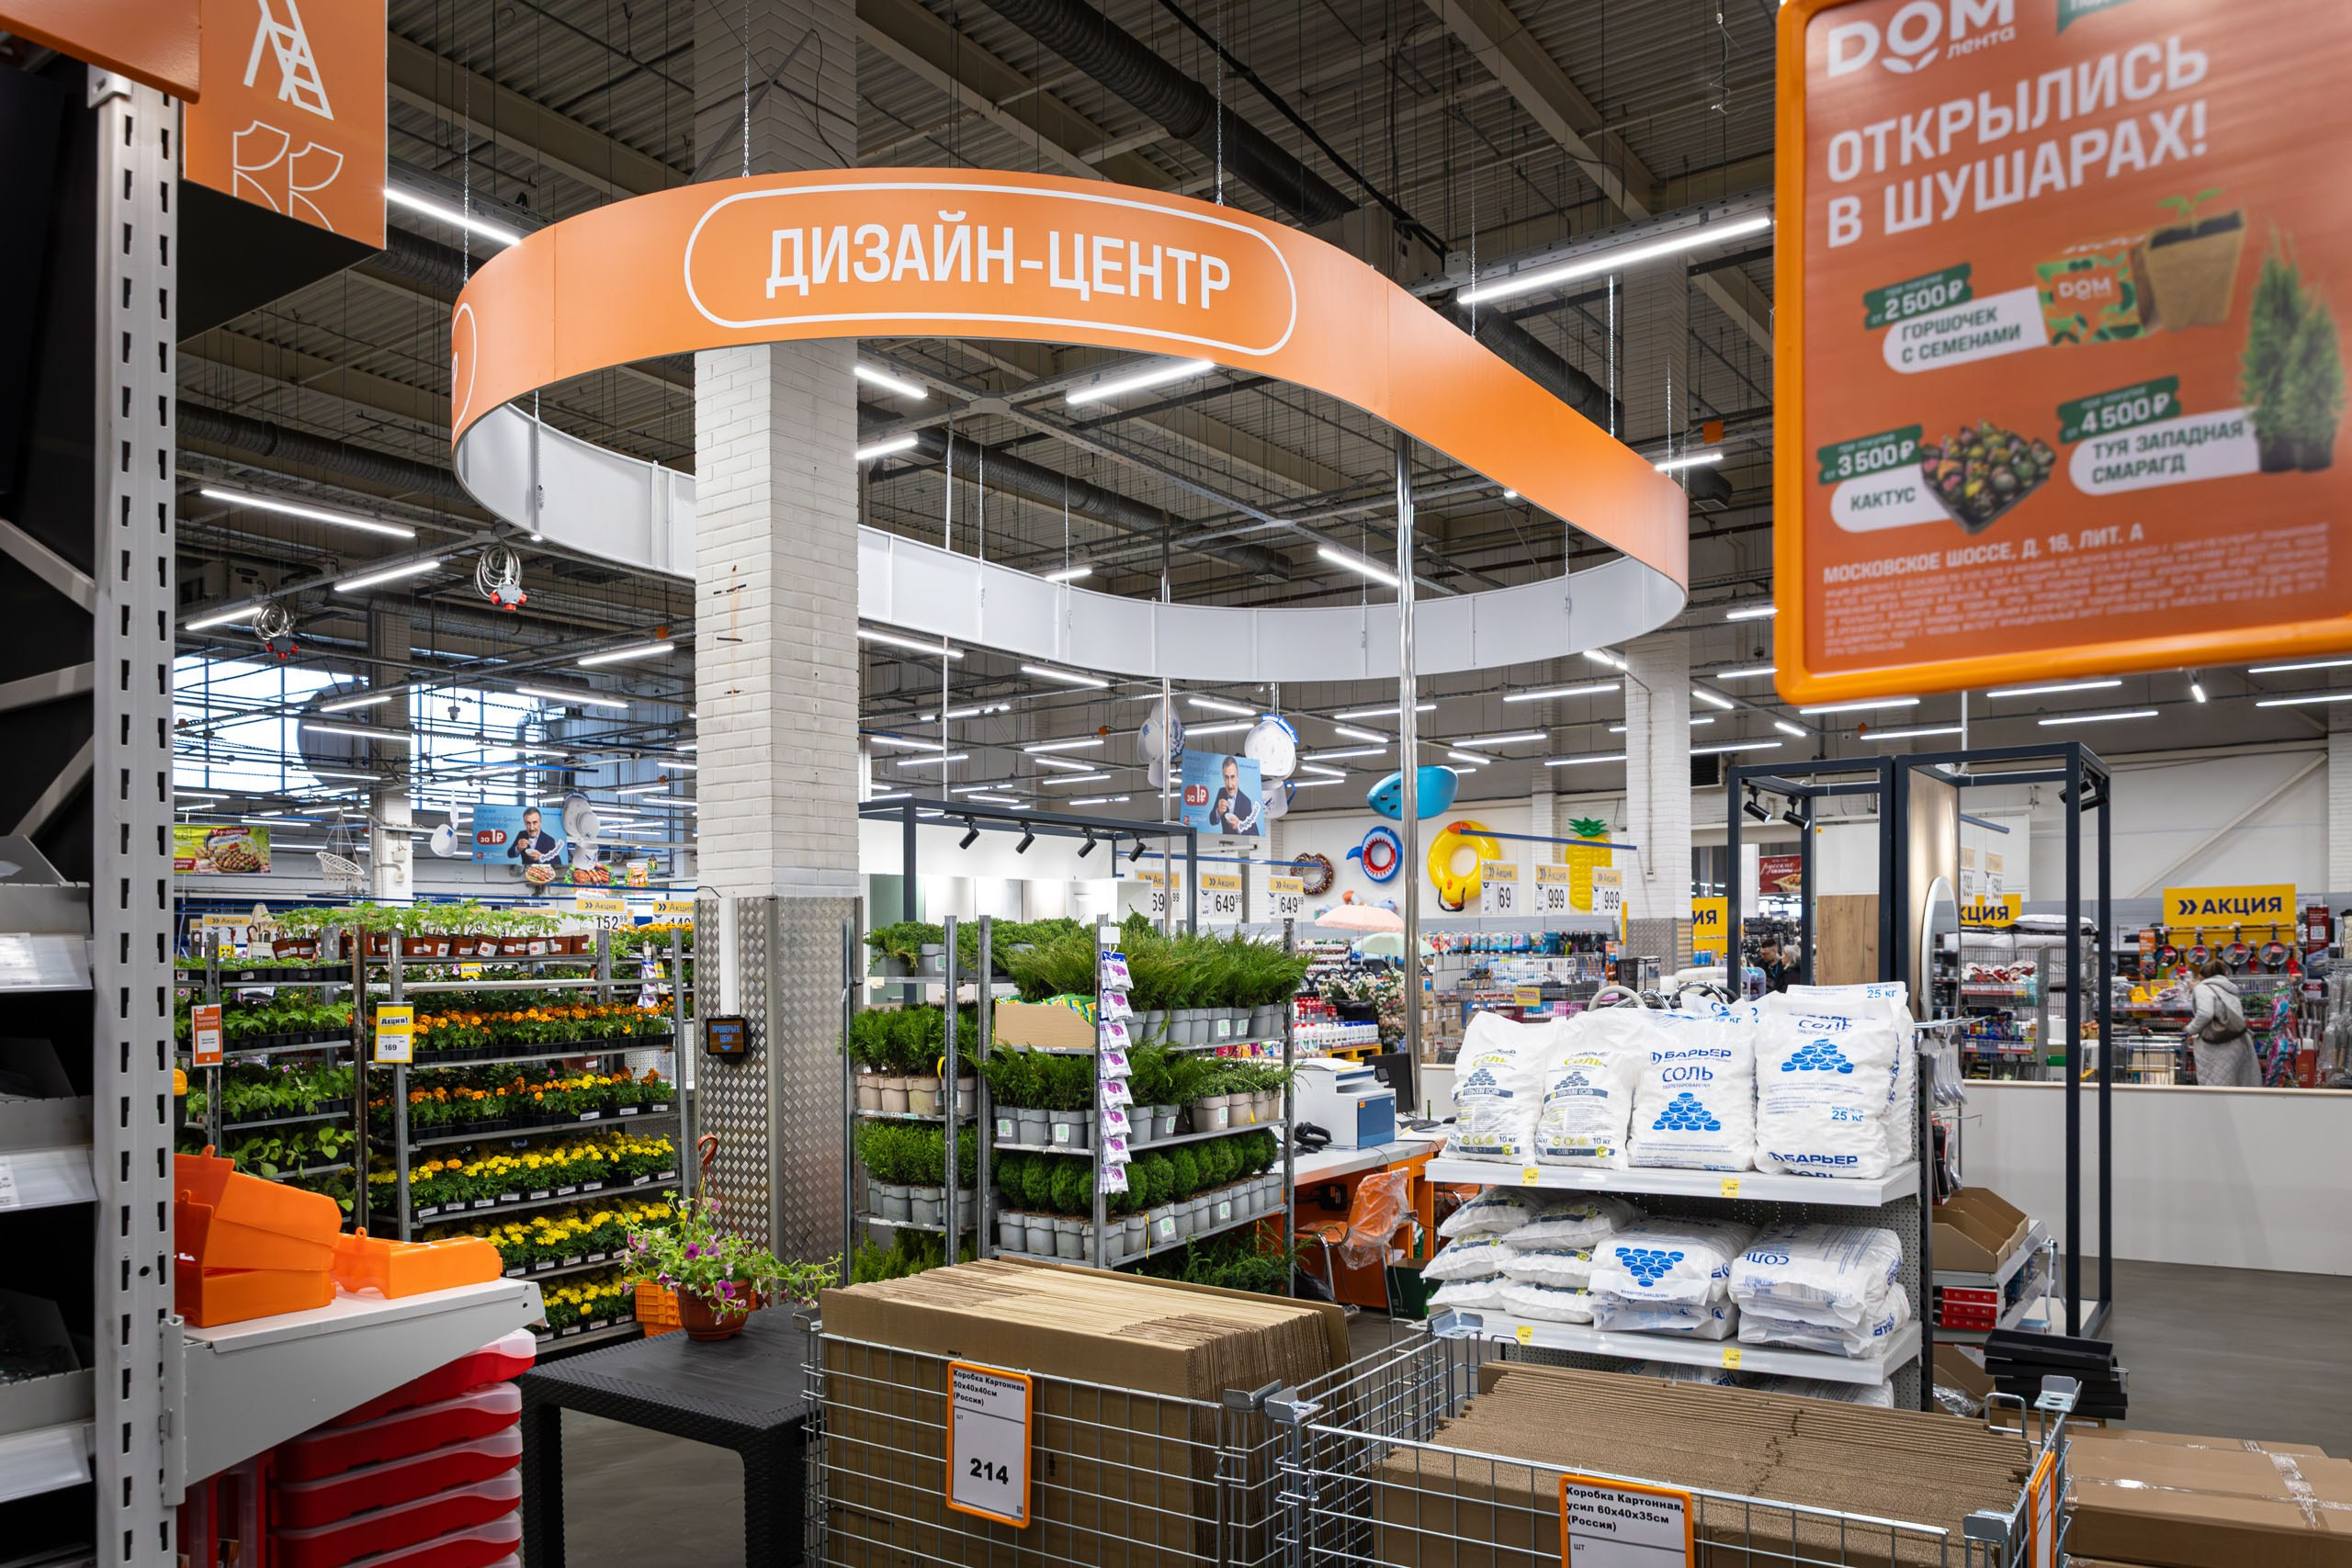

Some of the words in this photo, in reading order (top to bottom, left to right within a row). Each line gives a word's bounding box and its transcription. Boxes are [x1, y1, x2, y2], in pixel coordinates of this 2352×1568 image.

[1948, 26, 2016, 60] лента
[1827, 36, 2208, 183] ОТКРЫЛИСЬ
[1828, 196, 1863, 248] В
[1884, 100, 2208, 235] ШУШАРАХ!
[765, 210, 1230, 310] ДИЗАЙН-ЦЕНТР
[1902, 307, 1997, 341] ГОРШОЧЕК
[1902, 348, 1913, 364] С
[1919, 323, 2020, 360] СЕМЕНАМИ
[2092, 439, 2129, 459] ТУЯ
[2135, 420, 2244, 452] ЗАПАДНАЯ
[2092, 454, 2186, 484] СМАРАГД
[1851, 487, 1916, 512] КАКТУС
[1824, 552, 1940, 584] МОСКОВСКОЕ
[595, 901, 616, 910] Акция
[1216, 894, 1235, 912] 649
[1281, 897, 1297, 913] 649
[1499, 886, 1511, 908] 69
[1548, 888, 1565, 908] 999
[1604, 891, 1620, 909] 999
[2201, 897, 2282, 916] АКЦИЯ
[596, 916, 618, 930] 152
[1960, 906, 2008, 923] КЦИЯ
[1867, 989, 1882, 998] 25
[381, 1017, 409, 1025] Акция!
[1664, 1048, 1732, 1059] БАРЬЕР
[1662, 1066, 1713, 1083] СОЛЬ
[1831, 1111, 1848, 1120] 25
[1784, 1154, 1858, 1165] БАРЬЕР
[954, 1371, 983, 1383] Коробка
[985, 1376, 1024, 1392] Картонная
[954, 1392, 984, 1406] (Россия)
[970, 1457, 1009, 1484] 214
[1566, 1486, 1613, 1501] Коробка
[1617, 1495, 1684, 1513] Картонная,
[1566, 1502, 1594, 1512] усил
[1567, 1515, 1617, 1532] (Россия)
